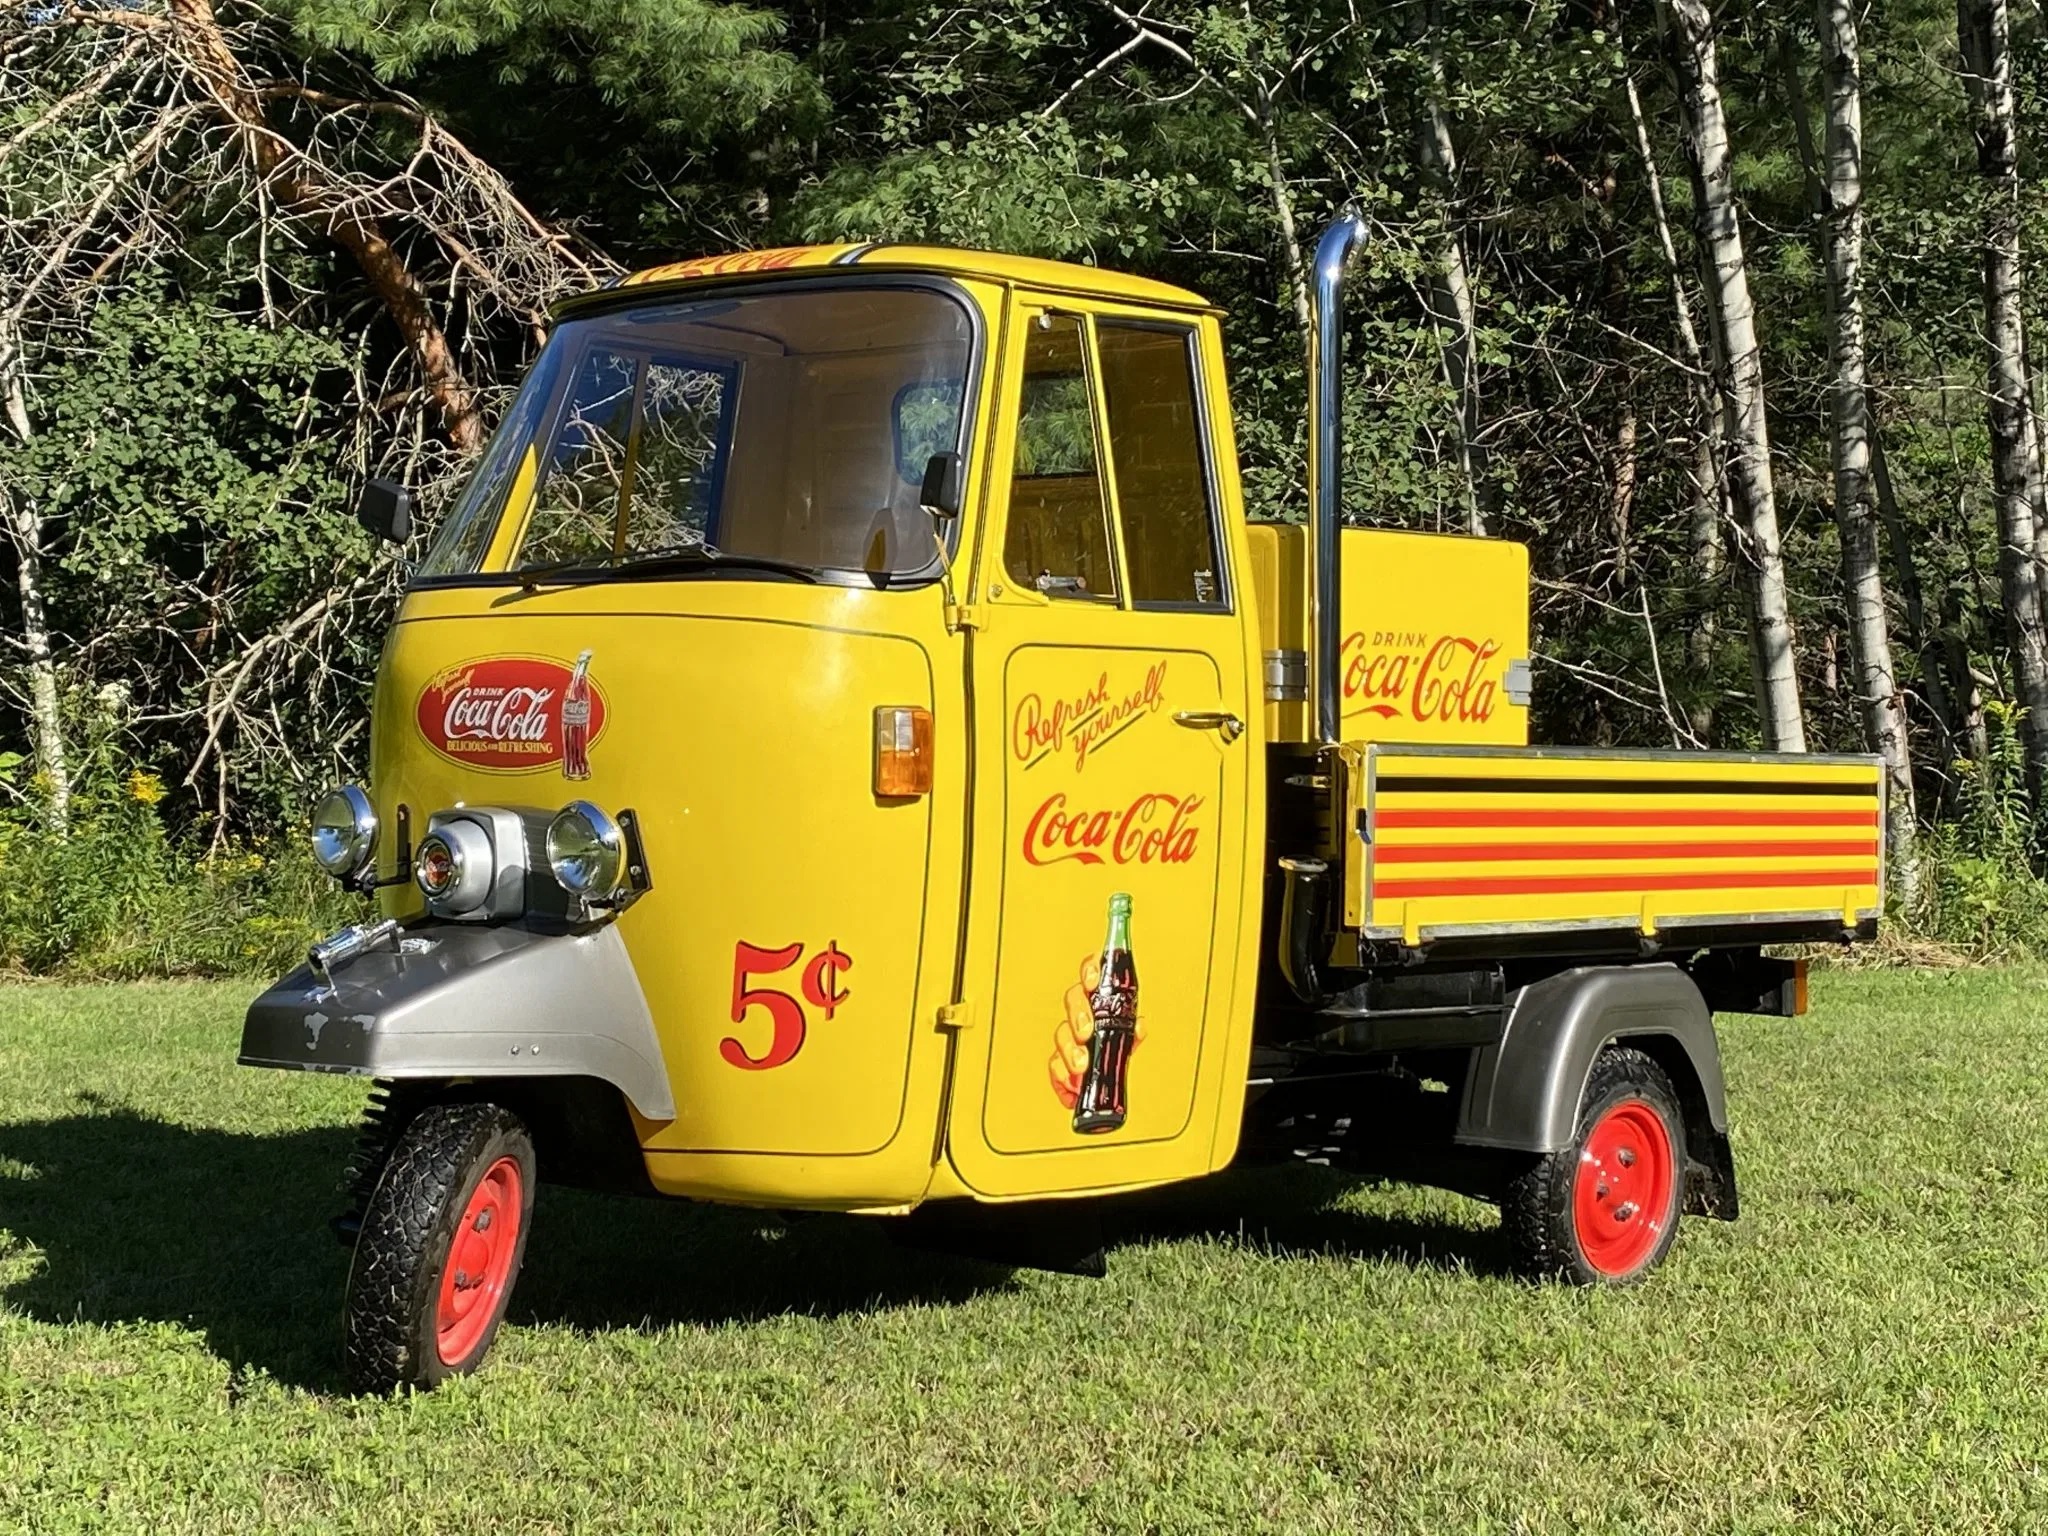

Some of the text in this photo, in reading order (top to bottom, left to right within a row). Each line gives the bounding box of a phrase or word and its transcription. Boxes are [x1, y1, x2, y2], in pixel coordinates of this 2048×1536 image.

[1371, 631, 1429, 649] DRINK
[443, 687, 556, 741] Coca-Cola
[472, 687, 506, 697] DRINK
[1013, 671, 1111, 761] Refresh
[1072, 659, 1166, 773] yourself
[446, 740, 488, 752] DELICIOUS
[498, 741, 553, 754] REFRESHING
[1022, 793, 1206, 867] Coca-Cola
[719, 938, 853, 1072] 5¢
